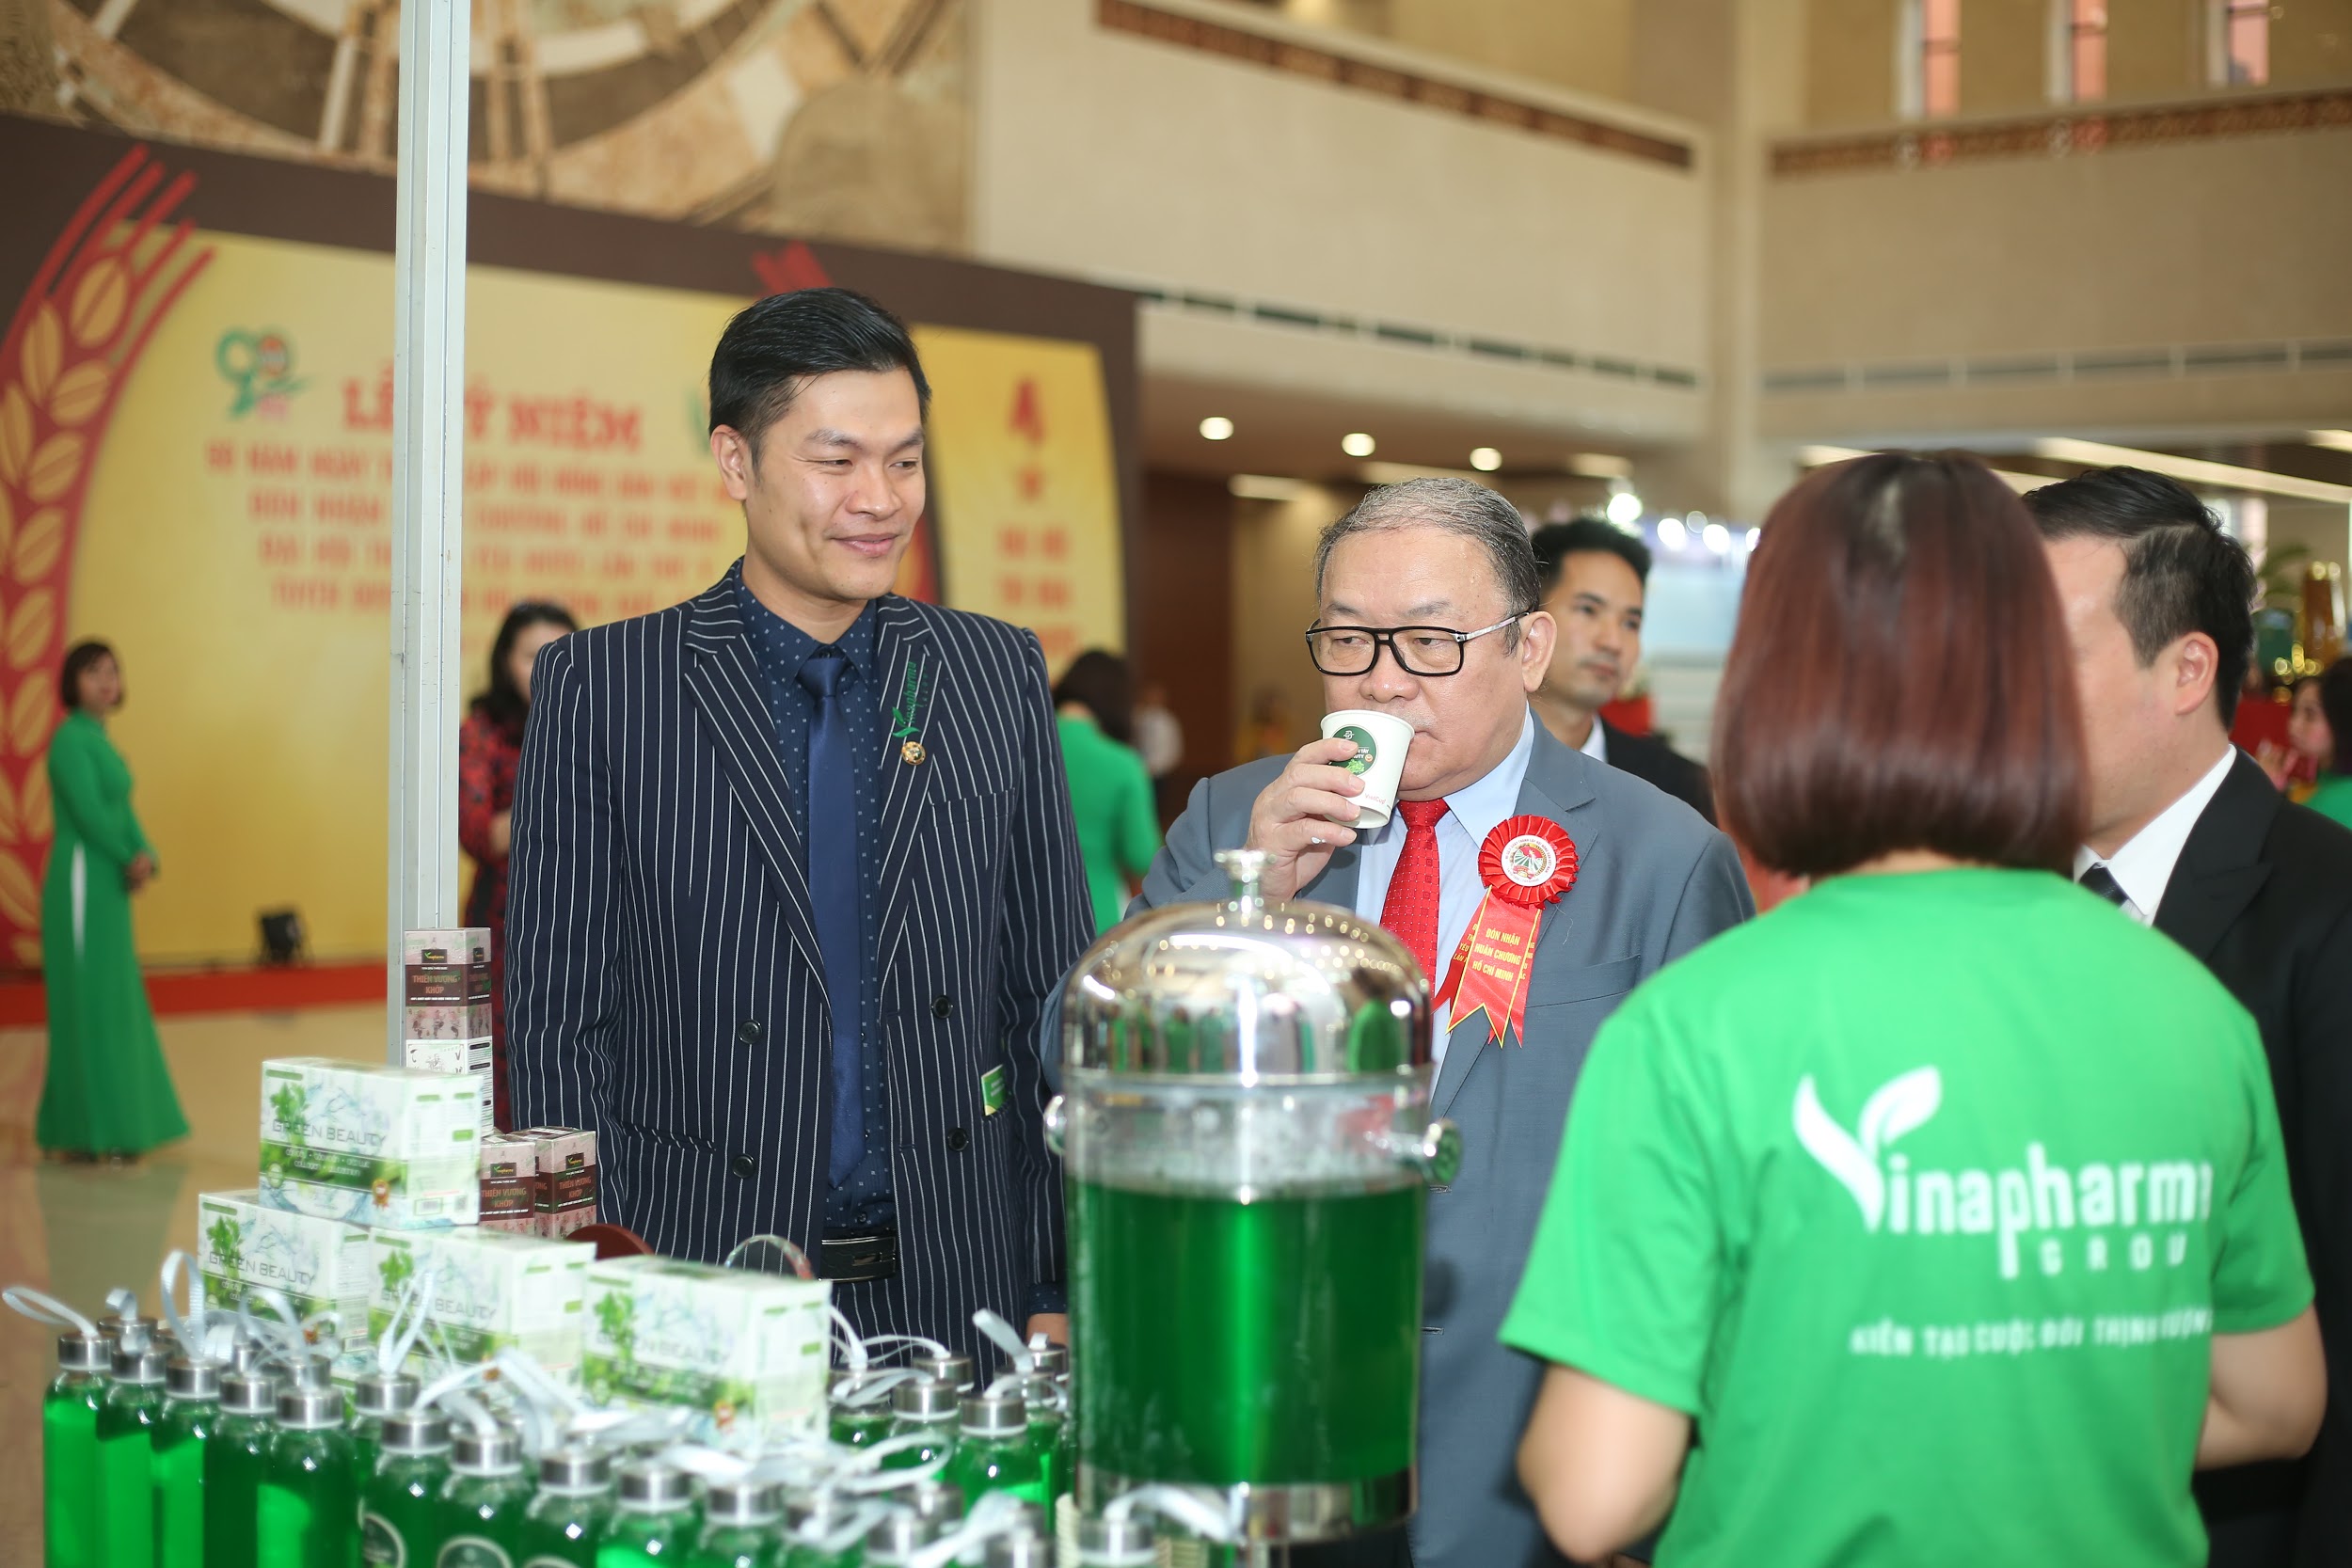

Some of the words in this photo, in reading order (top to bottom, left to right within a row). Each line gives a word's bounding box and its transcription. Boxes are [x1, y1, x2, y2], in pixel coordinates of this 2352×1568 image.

[1494, 968, 1514, 982] MINH
[326, 1127, 387, 1147] BEAUTY
[2040, 1233, 2187, 1275] GROU
[259, 1262, 317, 1286] BEAUTY
